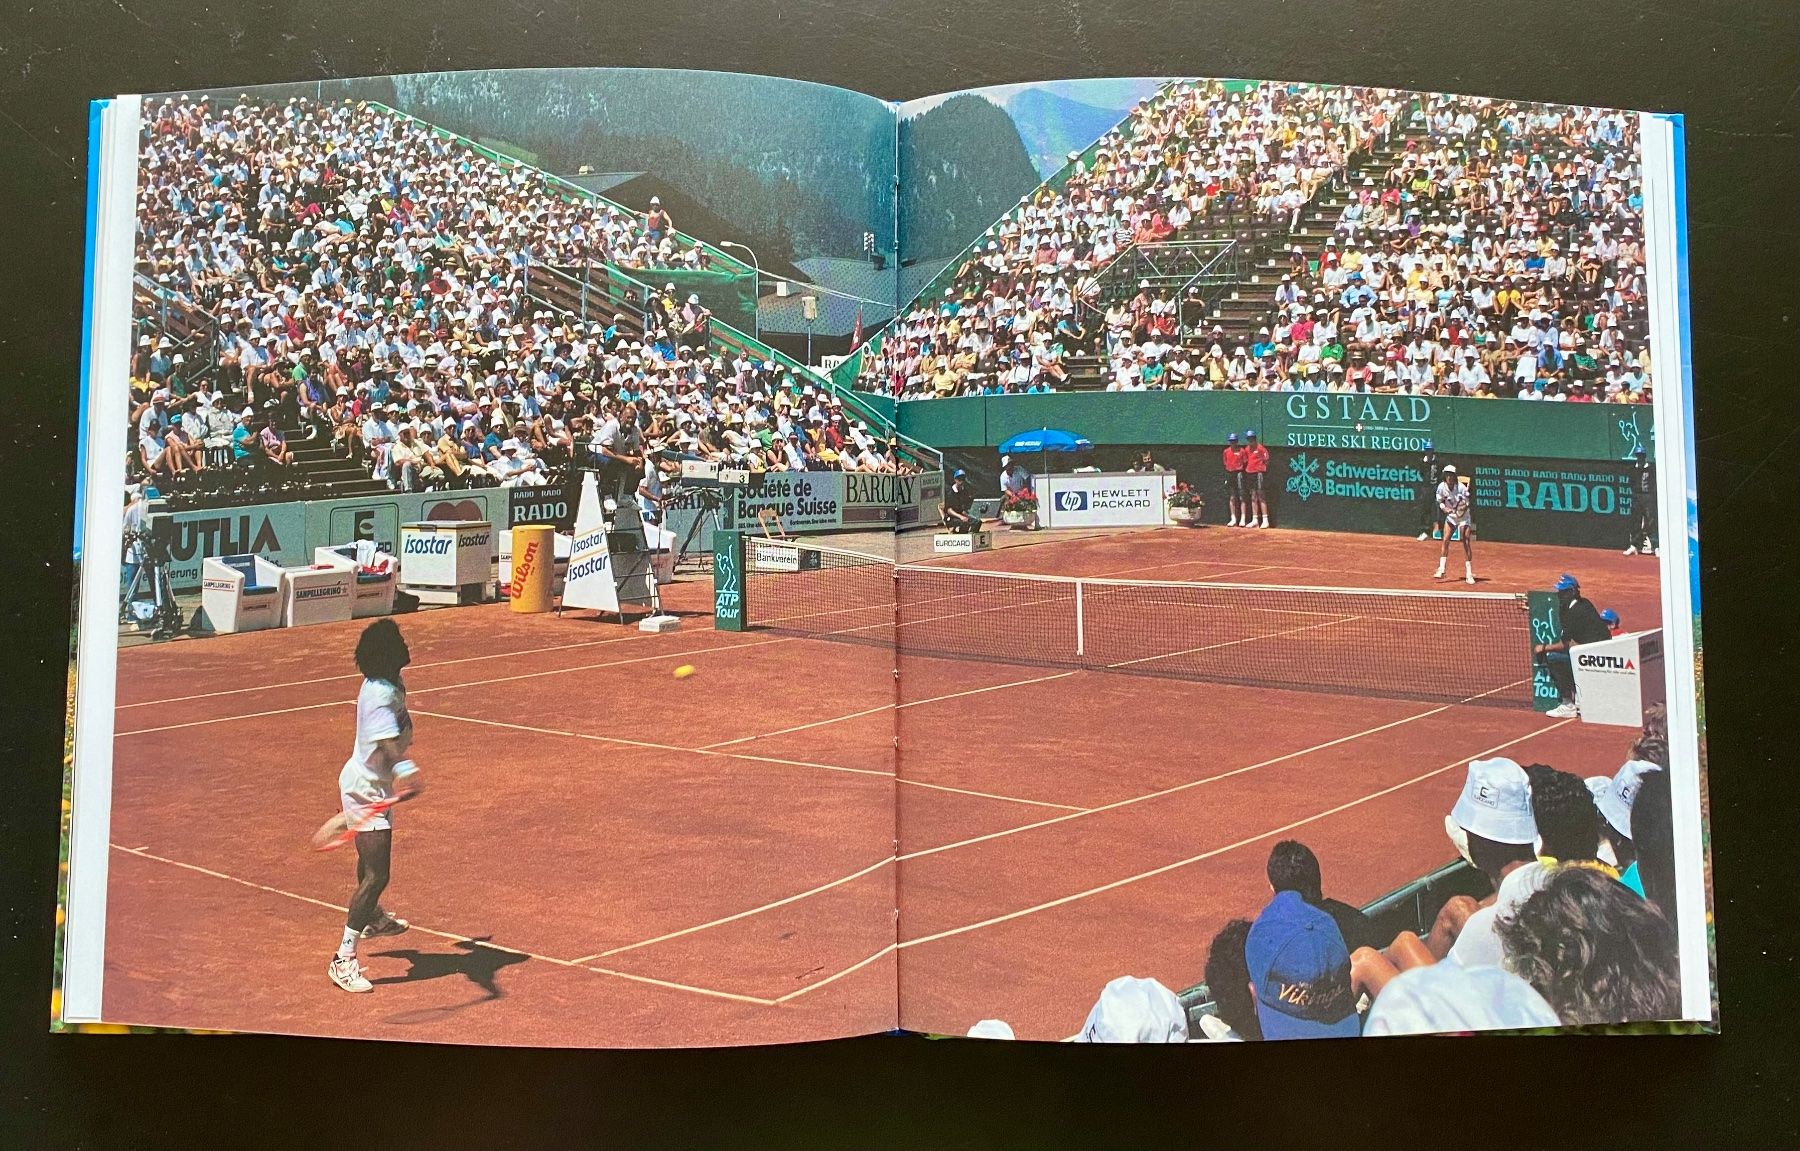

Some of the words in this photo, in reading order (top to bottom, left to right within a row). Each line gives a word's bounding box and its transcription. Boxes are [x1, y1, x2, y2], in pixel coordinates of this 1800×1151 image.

[1286, 394, 1431, 422] GSTAAD
[1287, 432, 1337, 448] SUPER
[1341, 434, 1366, 449] SKI
[1475, 467, 1500, 475] RADO
[1504, 468, 1530, 478] RADO
[1533, 470, 1558, 479] RADO
[1561, 472, 1586, 482] RADO
[1589, 474, 1615, 483] RADO
[1475, 478, 1500, 487] RADO
[513, 490, 535, 499] RADO
[541, 488, 562, 497] RADO
[793, 478, 812, 497] de
[846, 474, 917, 505] BARCLAY
[1092, 489, 1150, 498] HEWLETT
[1325, 479, 1415, 501] Bankverein
[1476, 488, 1501, 497] RADO
[1092, 499, 1151, 509] PACKARD
[1476, 498, 1502, 507] RADO
[1504, 479, 1615, 514] RADO
[513, 501, 568, 523] RADO
[796, 496, 837, 516] Suisse
[404, 534, 453, 555] isostar
[458, 533, 490, 549] isostar
[572, 532, 604, 554] isostar
[935, 539, 971, 547] EUROCARD
[756, 552, 798, 565] Bankverein
[512, 541, 540, 600] Wilson
[568, 554, 608, 582] isostar
[716, 593, 740, 606] ATP
[716, 605, 740, 619] Tour
[1533, 682, 1559, 699] Tou
